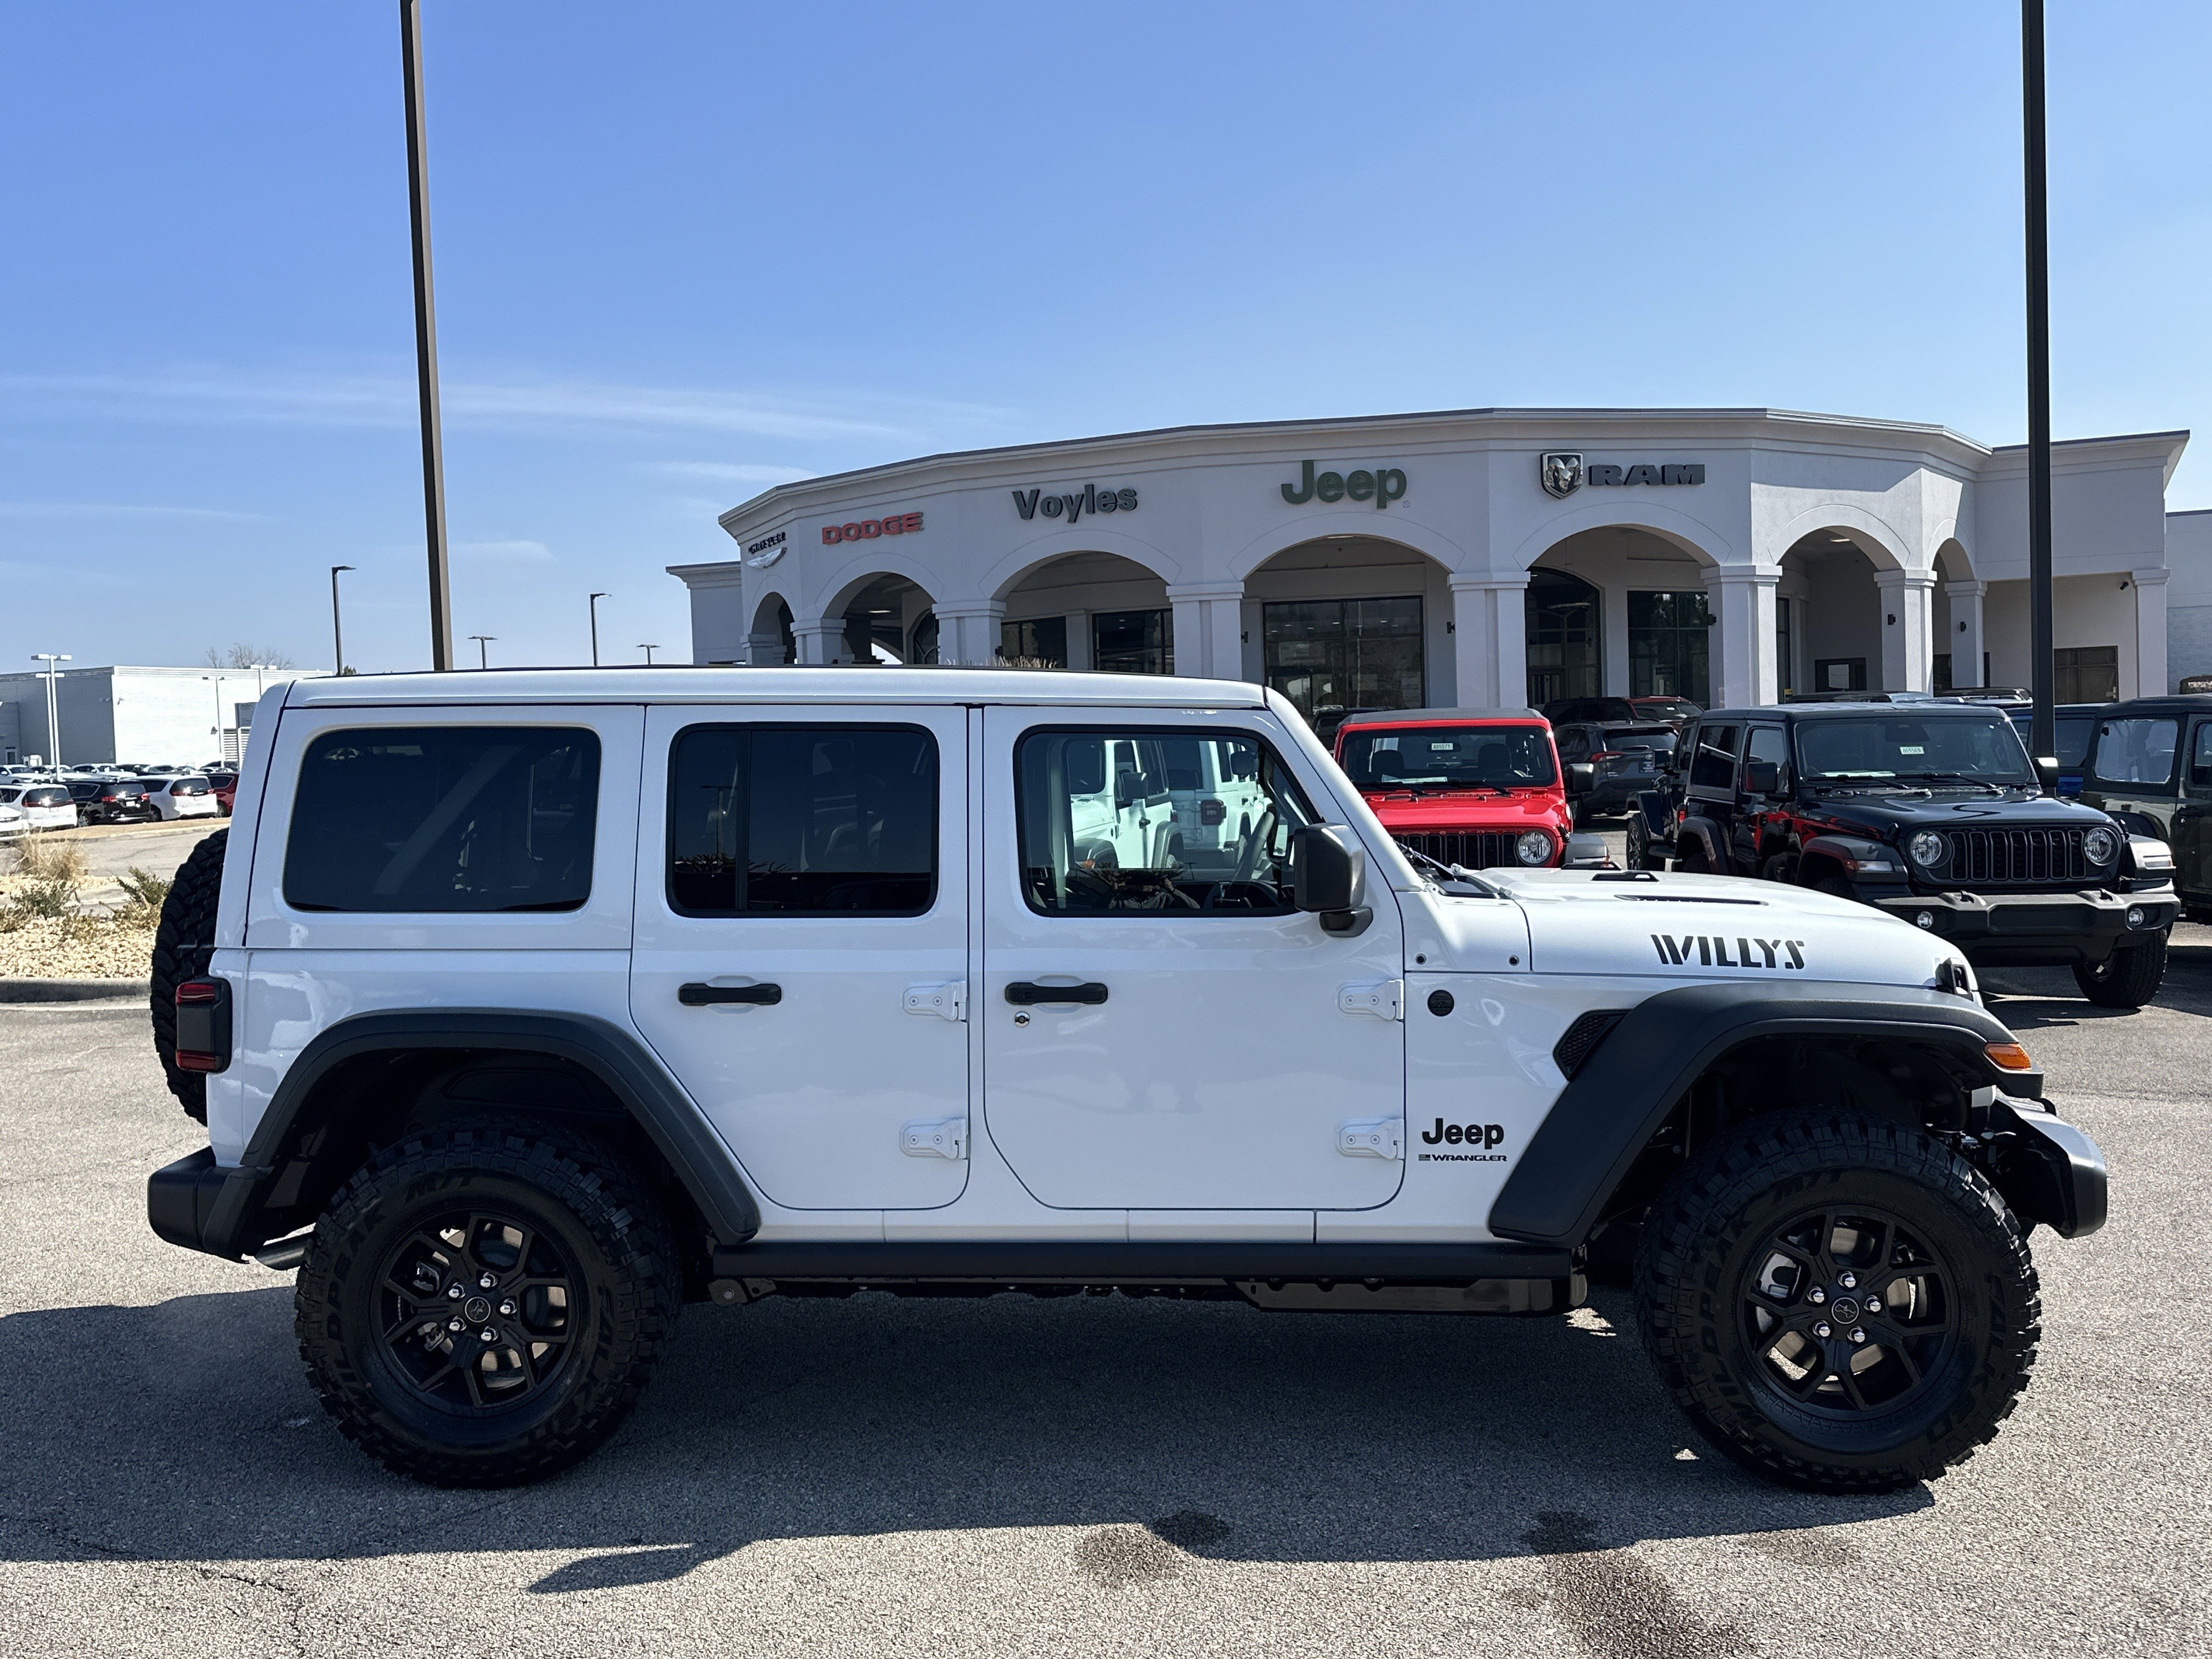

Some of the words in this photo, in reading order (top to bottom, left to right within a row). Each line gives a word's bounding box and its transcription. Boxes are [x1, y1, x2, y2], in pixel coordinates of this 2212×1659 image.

[1281, 460, 1407, 509] Jeep
[1588, 464, 1706, 486] RAM
[1012, 484, 1138, 523] Voyles
[822, 511, 924, 545] DODGE
[1650, 934, 1804, 969] WILLYS
[1422, 1118, 1504, 1150] Jeep
[1432, 1154, 1507, 1162] WRANGLER
[327, 1207, 387, 1417] WILDPEAK
[405, 1171, 476, 1203] M/T
[1699, 1209, 1768, 1431] WILDPEAK
[1925, 1274, 2004, 1447] FALKEN
